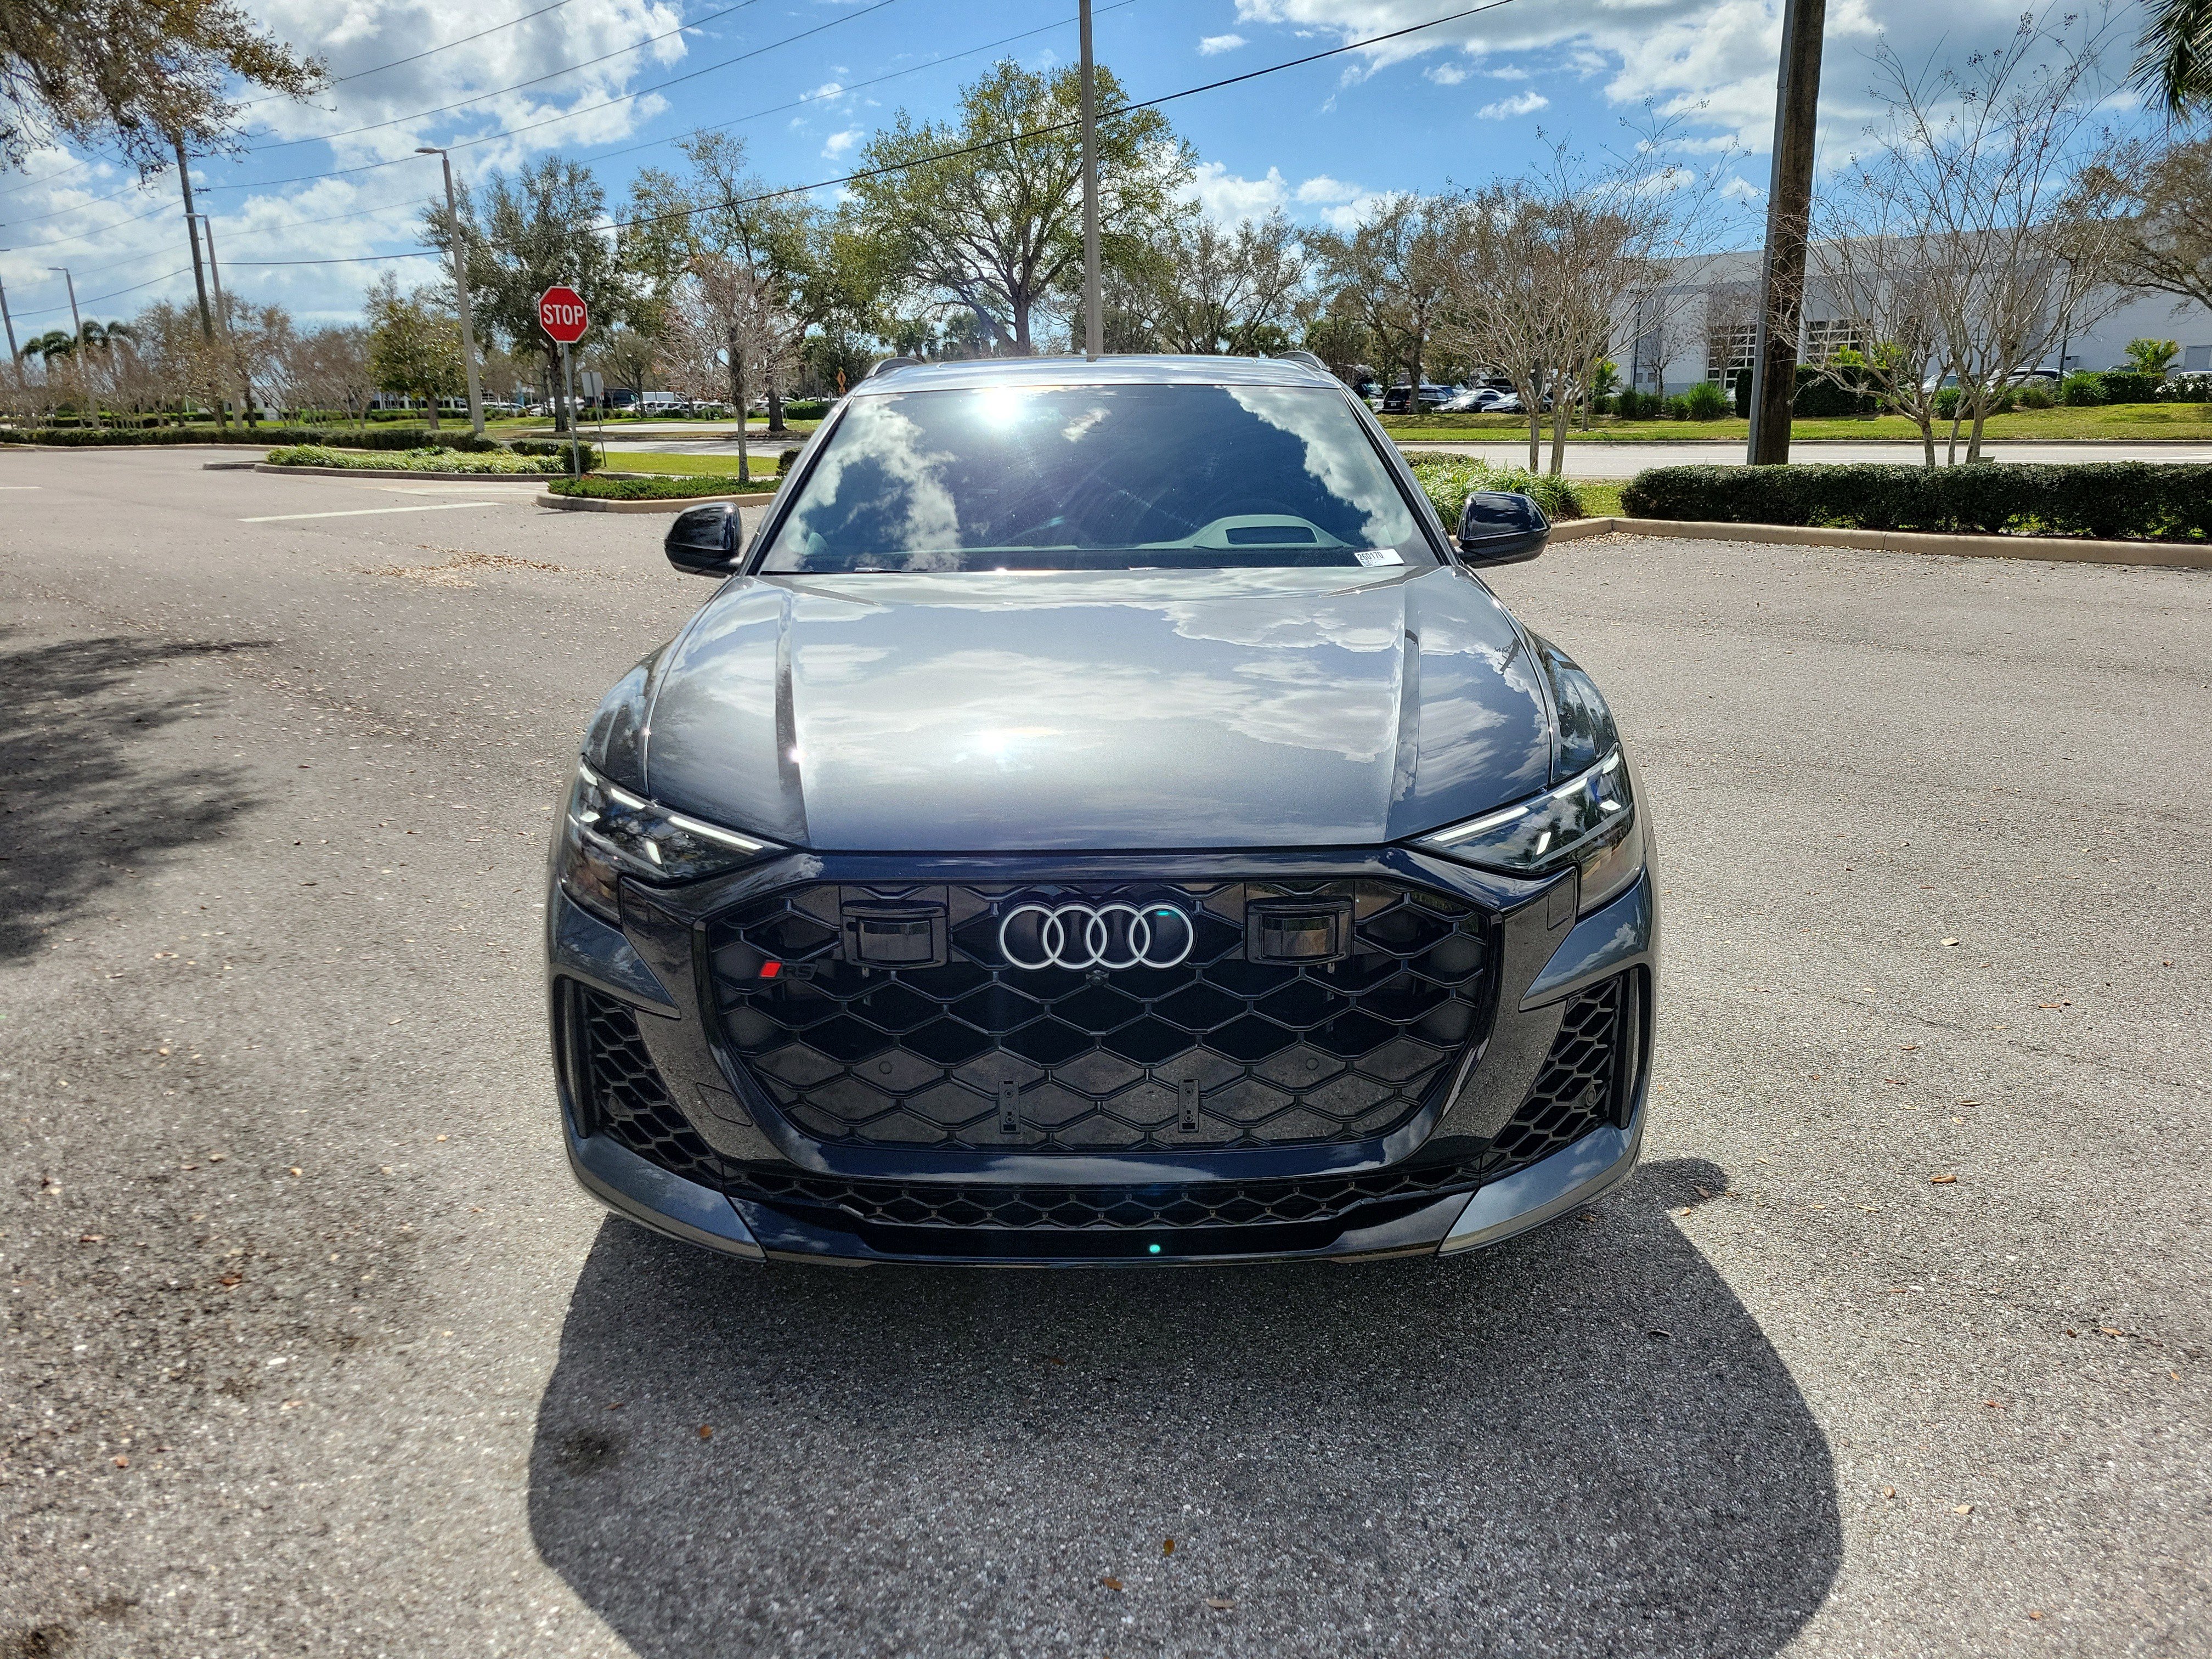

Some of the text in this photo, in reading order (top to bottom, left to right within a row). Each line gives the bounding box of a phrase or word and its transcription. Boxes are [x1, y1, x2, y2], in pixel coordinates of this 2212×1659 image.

[543, 304, 584, 325] STOP
[1357, 551, 1384, 561] 260170
[782, 965, 812, 978] RS
